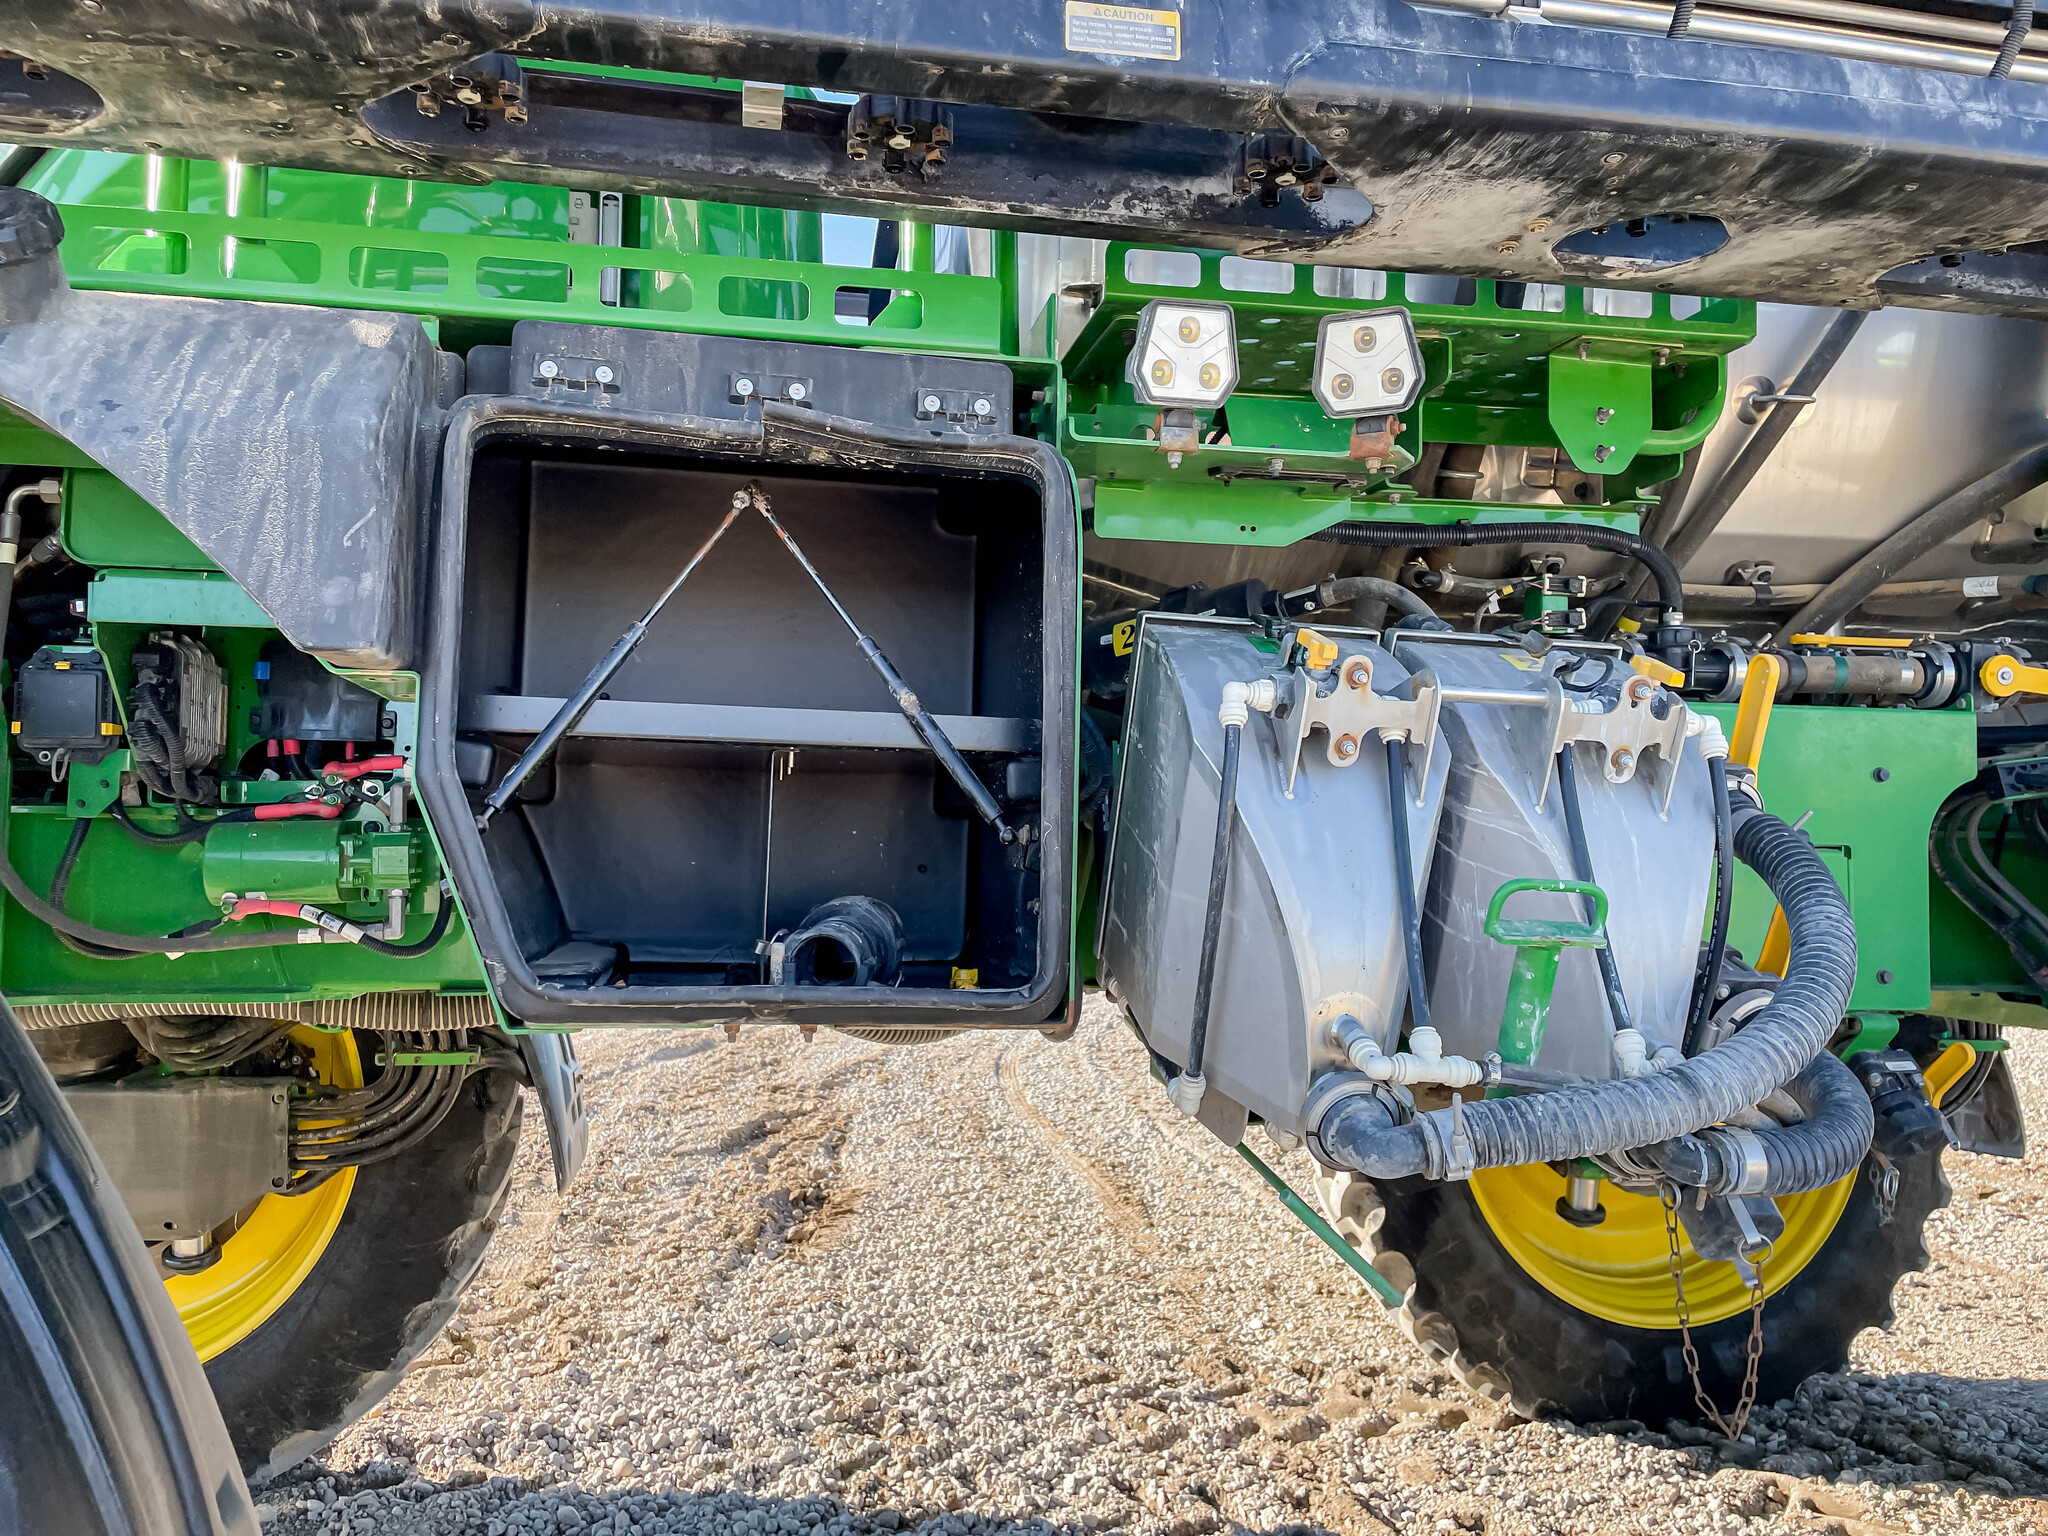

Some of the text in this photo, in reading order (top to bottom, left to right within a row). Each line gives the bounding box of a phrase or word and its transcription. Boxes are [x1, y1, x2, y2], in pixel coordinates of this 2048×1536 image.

[1103, 9, 1154, 21] CAUTION
[1072, 19, 1087, 27] Spray
[1121, 624, 1135, 650] 2
